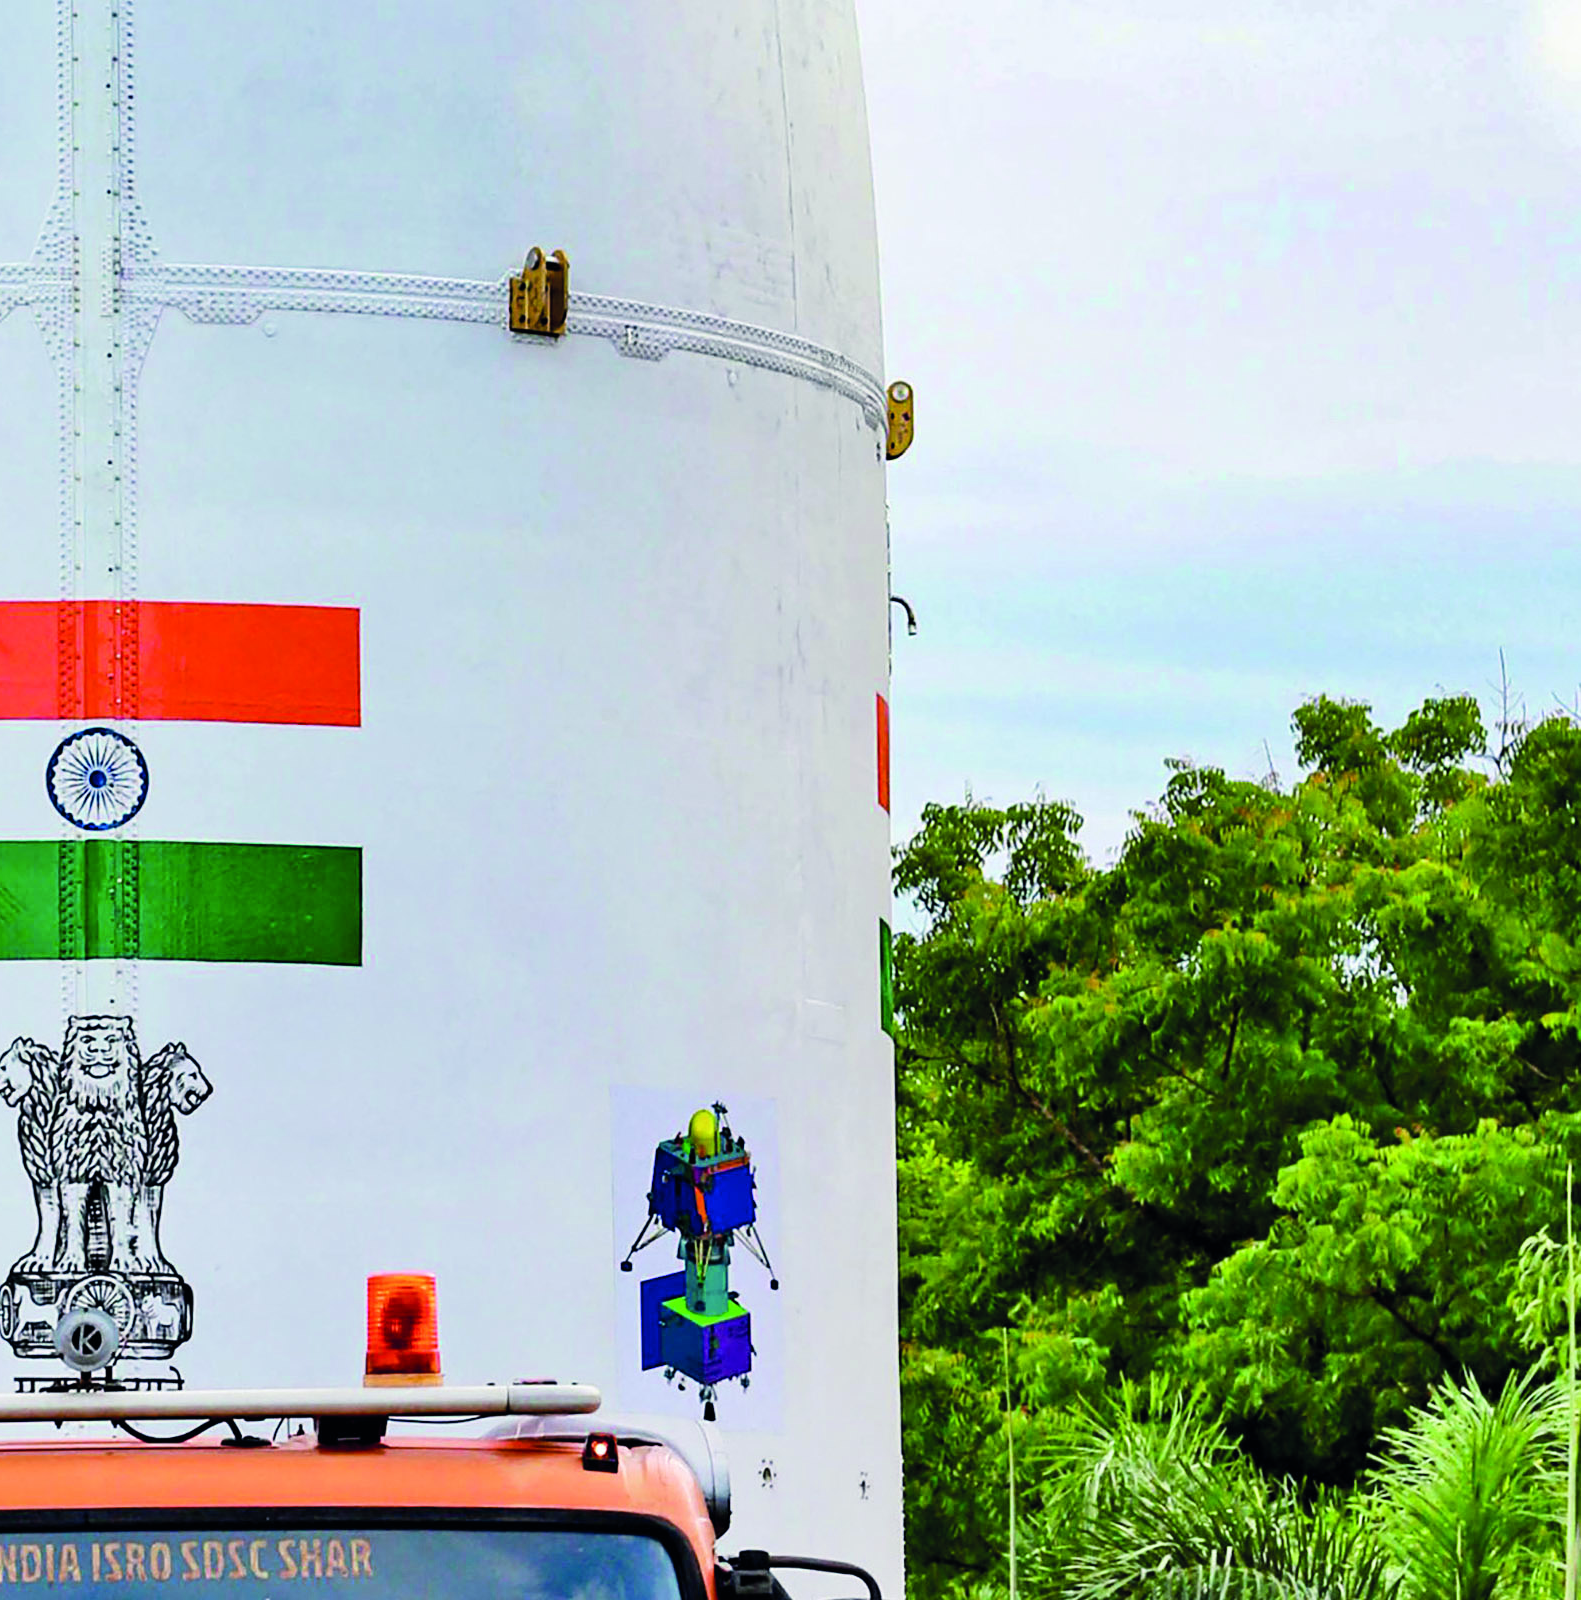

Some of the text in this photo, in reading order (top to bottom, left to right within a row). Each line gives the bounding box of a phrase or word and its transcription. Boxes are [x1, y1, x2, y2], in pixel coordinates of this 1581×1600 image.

[91, 1542, 171, 1582] ISRO
[181, 1540, 268, 1580] SDSC
[277, 1539, 372, 1578] SHAR
